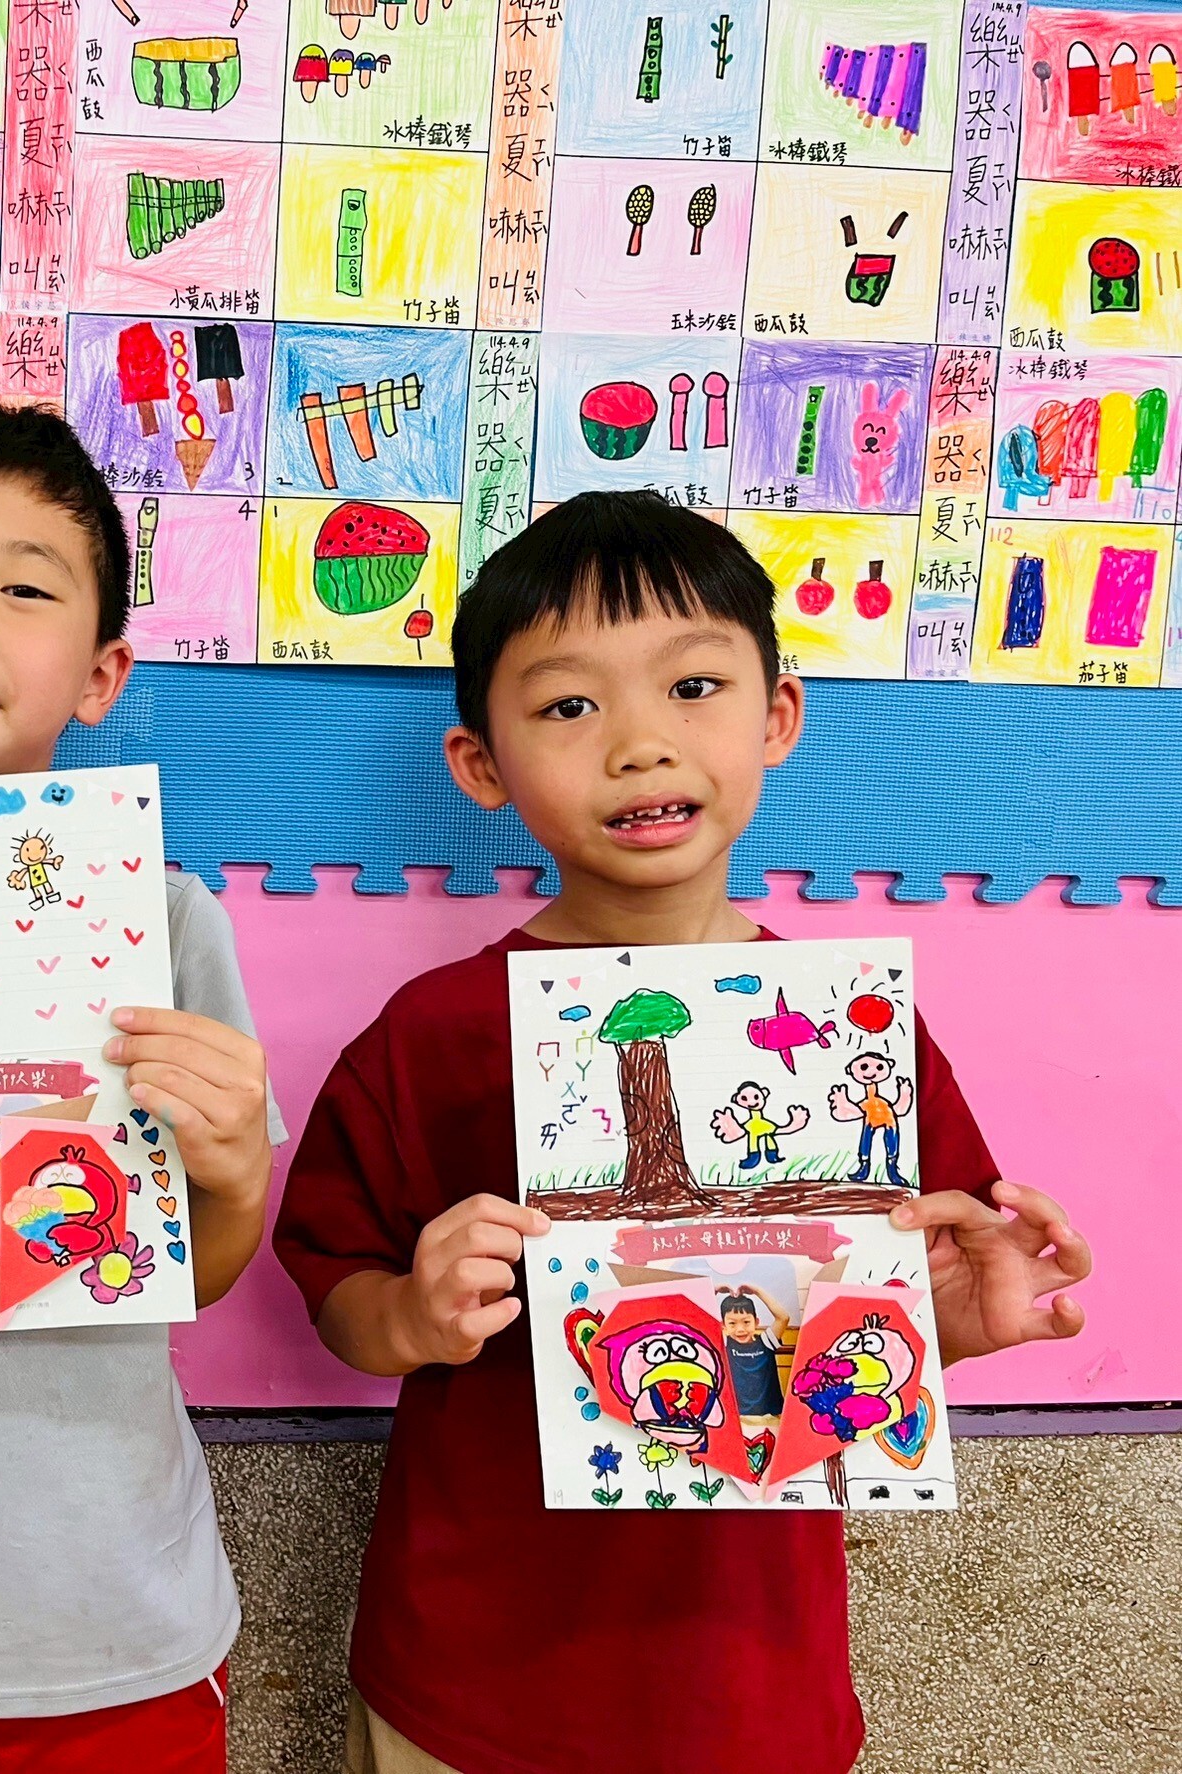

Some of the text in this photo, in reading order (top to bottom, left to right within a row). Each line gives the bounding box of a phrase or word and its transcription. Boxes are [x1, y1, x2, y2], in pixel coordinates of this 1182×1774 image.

[82, 39, 104, 121] 西瓜鼓
[682, 133, 732, 158] 竹子笛
[170, 285, 260, 314] 小黃瓜排笛
[403, 297, 460, 325] 竹子笛
[18, 317, 58, 328] 114.4.9
[670, 310, 736, 332] 玉米沙鈴
[754, 314, 810, 334] 西瓜鼓
[489, 336, 530, 349] 114.4.9
[1008, 327, 1066, 352] 西瓜鼓
[949, 350, 991, 361] 114.4.9
[243, 462, 255, 481] 3
[466, 349, 513, 580] 樂器夏
[744, 485, 799, 508] 竹子笛
[238, 500, 255, 521] 4
[174, 638, 230, 661] 竹子笛
[273, 641, 333, 660] 西瓜鼓
[1078, 661, 1128, 684] 茄子笛
